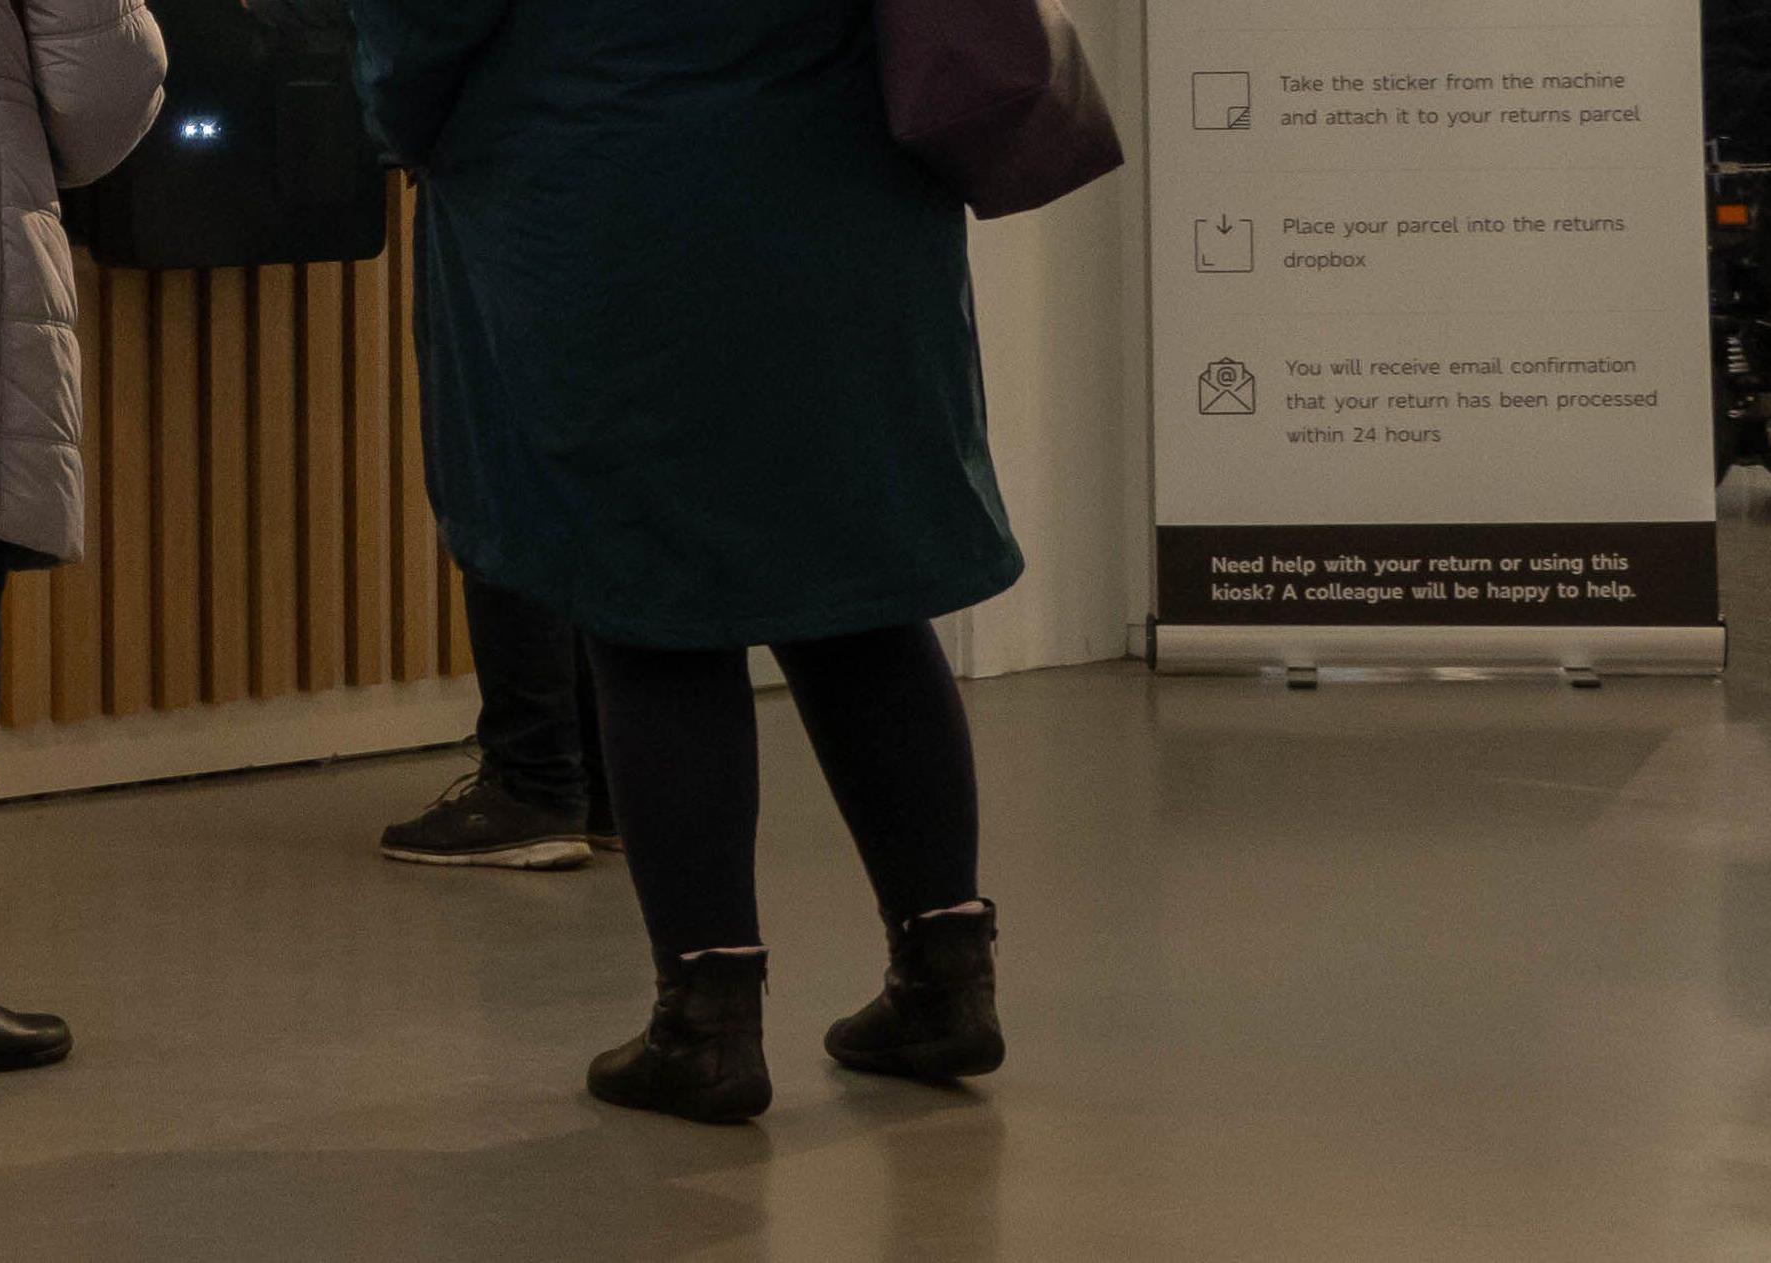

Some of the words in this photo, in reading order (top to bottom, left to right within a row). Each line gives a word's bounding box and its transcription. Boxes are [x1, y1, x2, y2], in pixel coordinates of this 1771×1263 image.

[1279, 75, 1324, 92] Take
[1331, 75, 1364, 92] the
[1372, 75, 1437, 92] sticker
[1446, 73, 1493, 91] from
[1501, 73, 1534, 90] the
[1542, 72, 1626, 89] machine
[1280, 109, 1318, 126] and
[1325, 108, 1388, 126] attach
[1396, 109, 1409, 125] it
[1417, 108, 1439, 125] to
[1446, 110, 1492, 128] your
[1500, 108, 1572, 124] returns
[1579, 105, 1641, 126] parcel
[1283, 217, 1336, 235] Place
[1343, 220, 1389, 239] your
[1397, 216, 1459, 237] parcel
[1467, 218, 1506, 233] into
[1512, 216, 1546, 233] the
[1553, 217, 1626, 232] returns
[1283, 251, 1366, 271] dropbox
[1285, 360, 1322, 377] You
[1329, 358, 1362, 376] will
[1370, 361, 1441, 376] receive
[1449, 357, 1503, 375] email
[1510, 356, 1637, 375] confirmation
[1286, 393, 1326, 410] that
[1334, 396, 1379, 415] your
[1387, 393, 1449, 409] return
[1457, 392, 1492, 409] has
[1499, 391, 1548, 408] been
[1556, 390, 1658, 410] processed
[1286, 427, 1344, 444] within
[1353, 426, 1377, 443] 24
[1385, 426, 1442, 443] hours
[1211, 556, 1264, 574] Need
[1272, 555, 1316, 576] help
[1324, 554, 1367, 573] with
[1374, 559, 1421, 577] your
[1429, 555, 1492, 572] return
[1499, 558, 1522, 572] or
[1529, 558, 1584, 575] using
[1591, 552, 1629, 571] this
[1212, 583, 1275, 601] kiosk?
[1282, 583, 1298, 600] A
[1304, 583, 1404, 604] colleague
[1411, 581, 1447, 599] will
[1454, 582, 1479, 599] be
[1487, 582, 1550, 603] happy
[1557, 582, 1579, 599] to
[1587, 580, 1636, 602] help.
